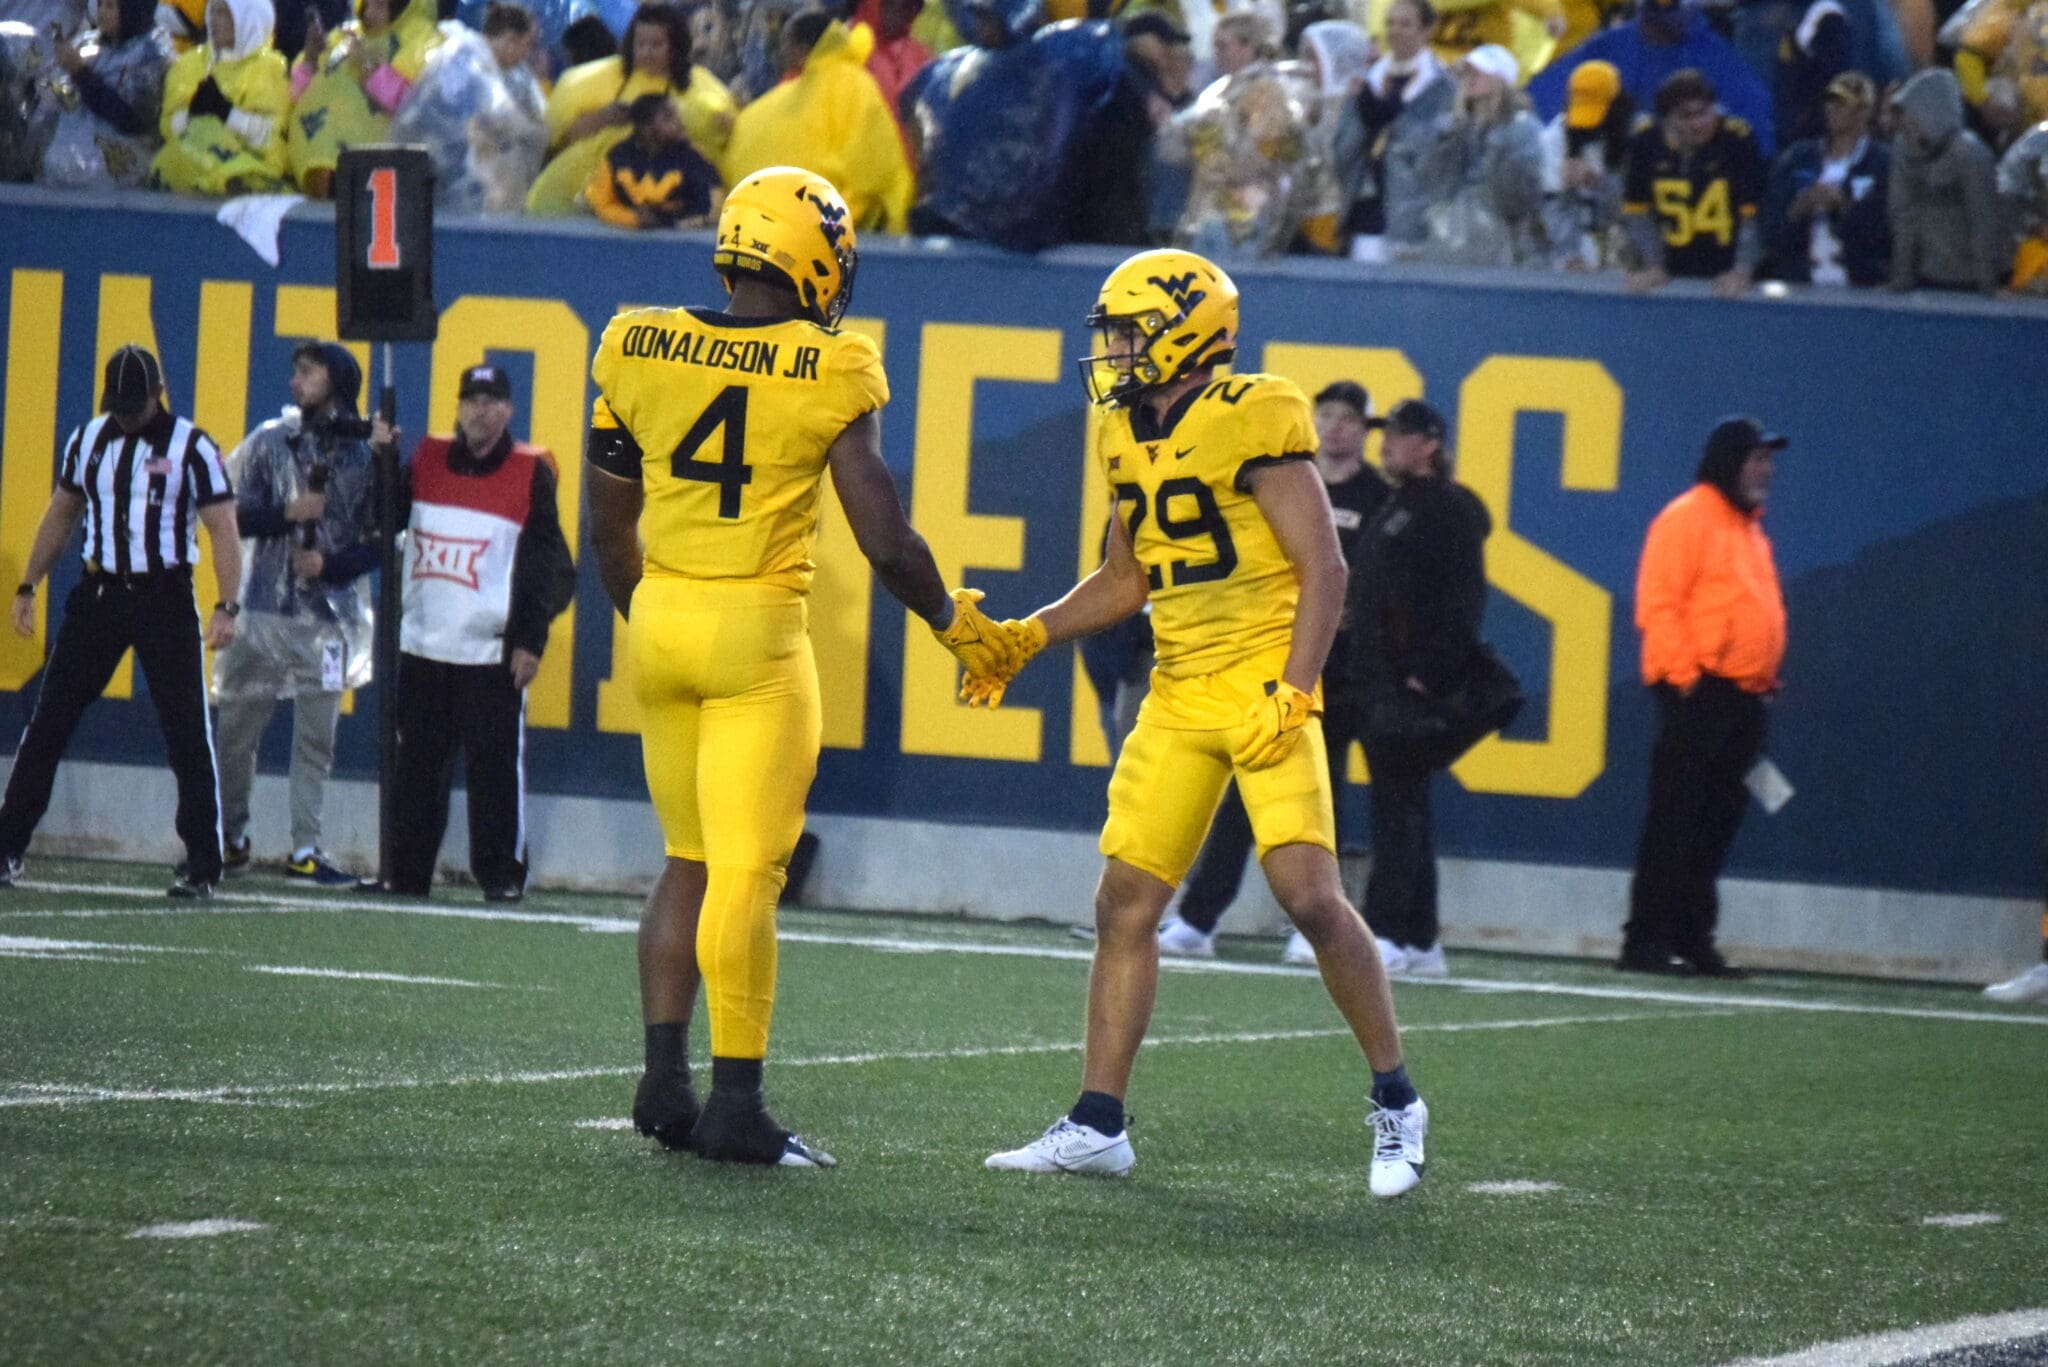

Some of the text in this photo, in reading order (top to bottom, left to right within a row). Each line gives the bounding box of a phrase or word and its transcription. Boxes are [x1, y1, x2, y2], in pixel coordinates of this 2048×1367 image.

[367, 168, 400, 269] 1
[731, 232, 740, 248] 4
[1653, 179, 1733, 247] 54
[622, 325, 820, 381] DONALDSON JR
[671, 385, 753, 519] 4
[413, 537, 477, 582] XII
[1112, 476, 1238, 590] 29
